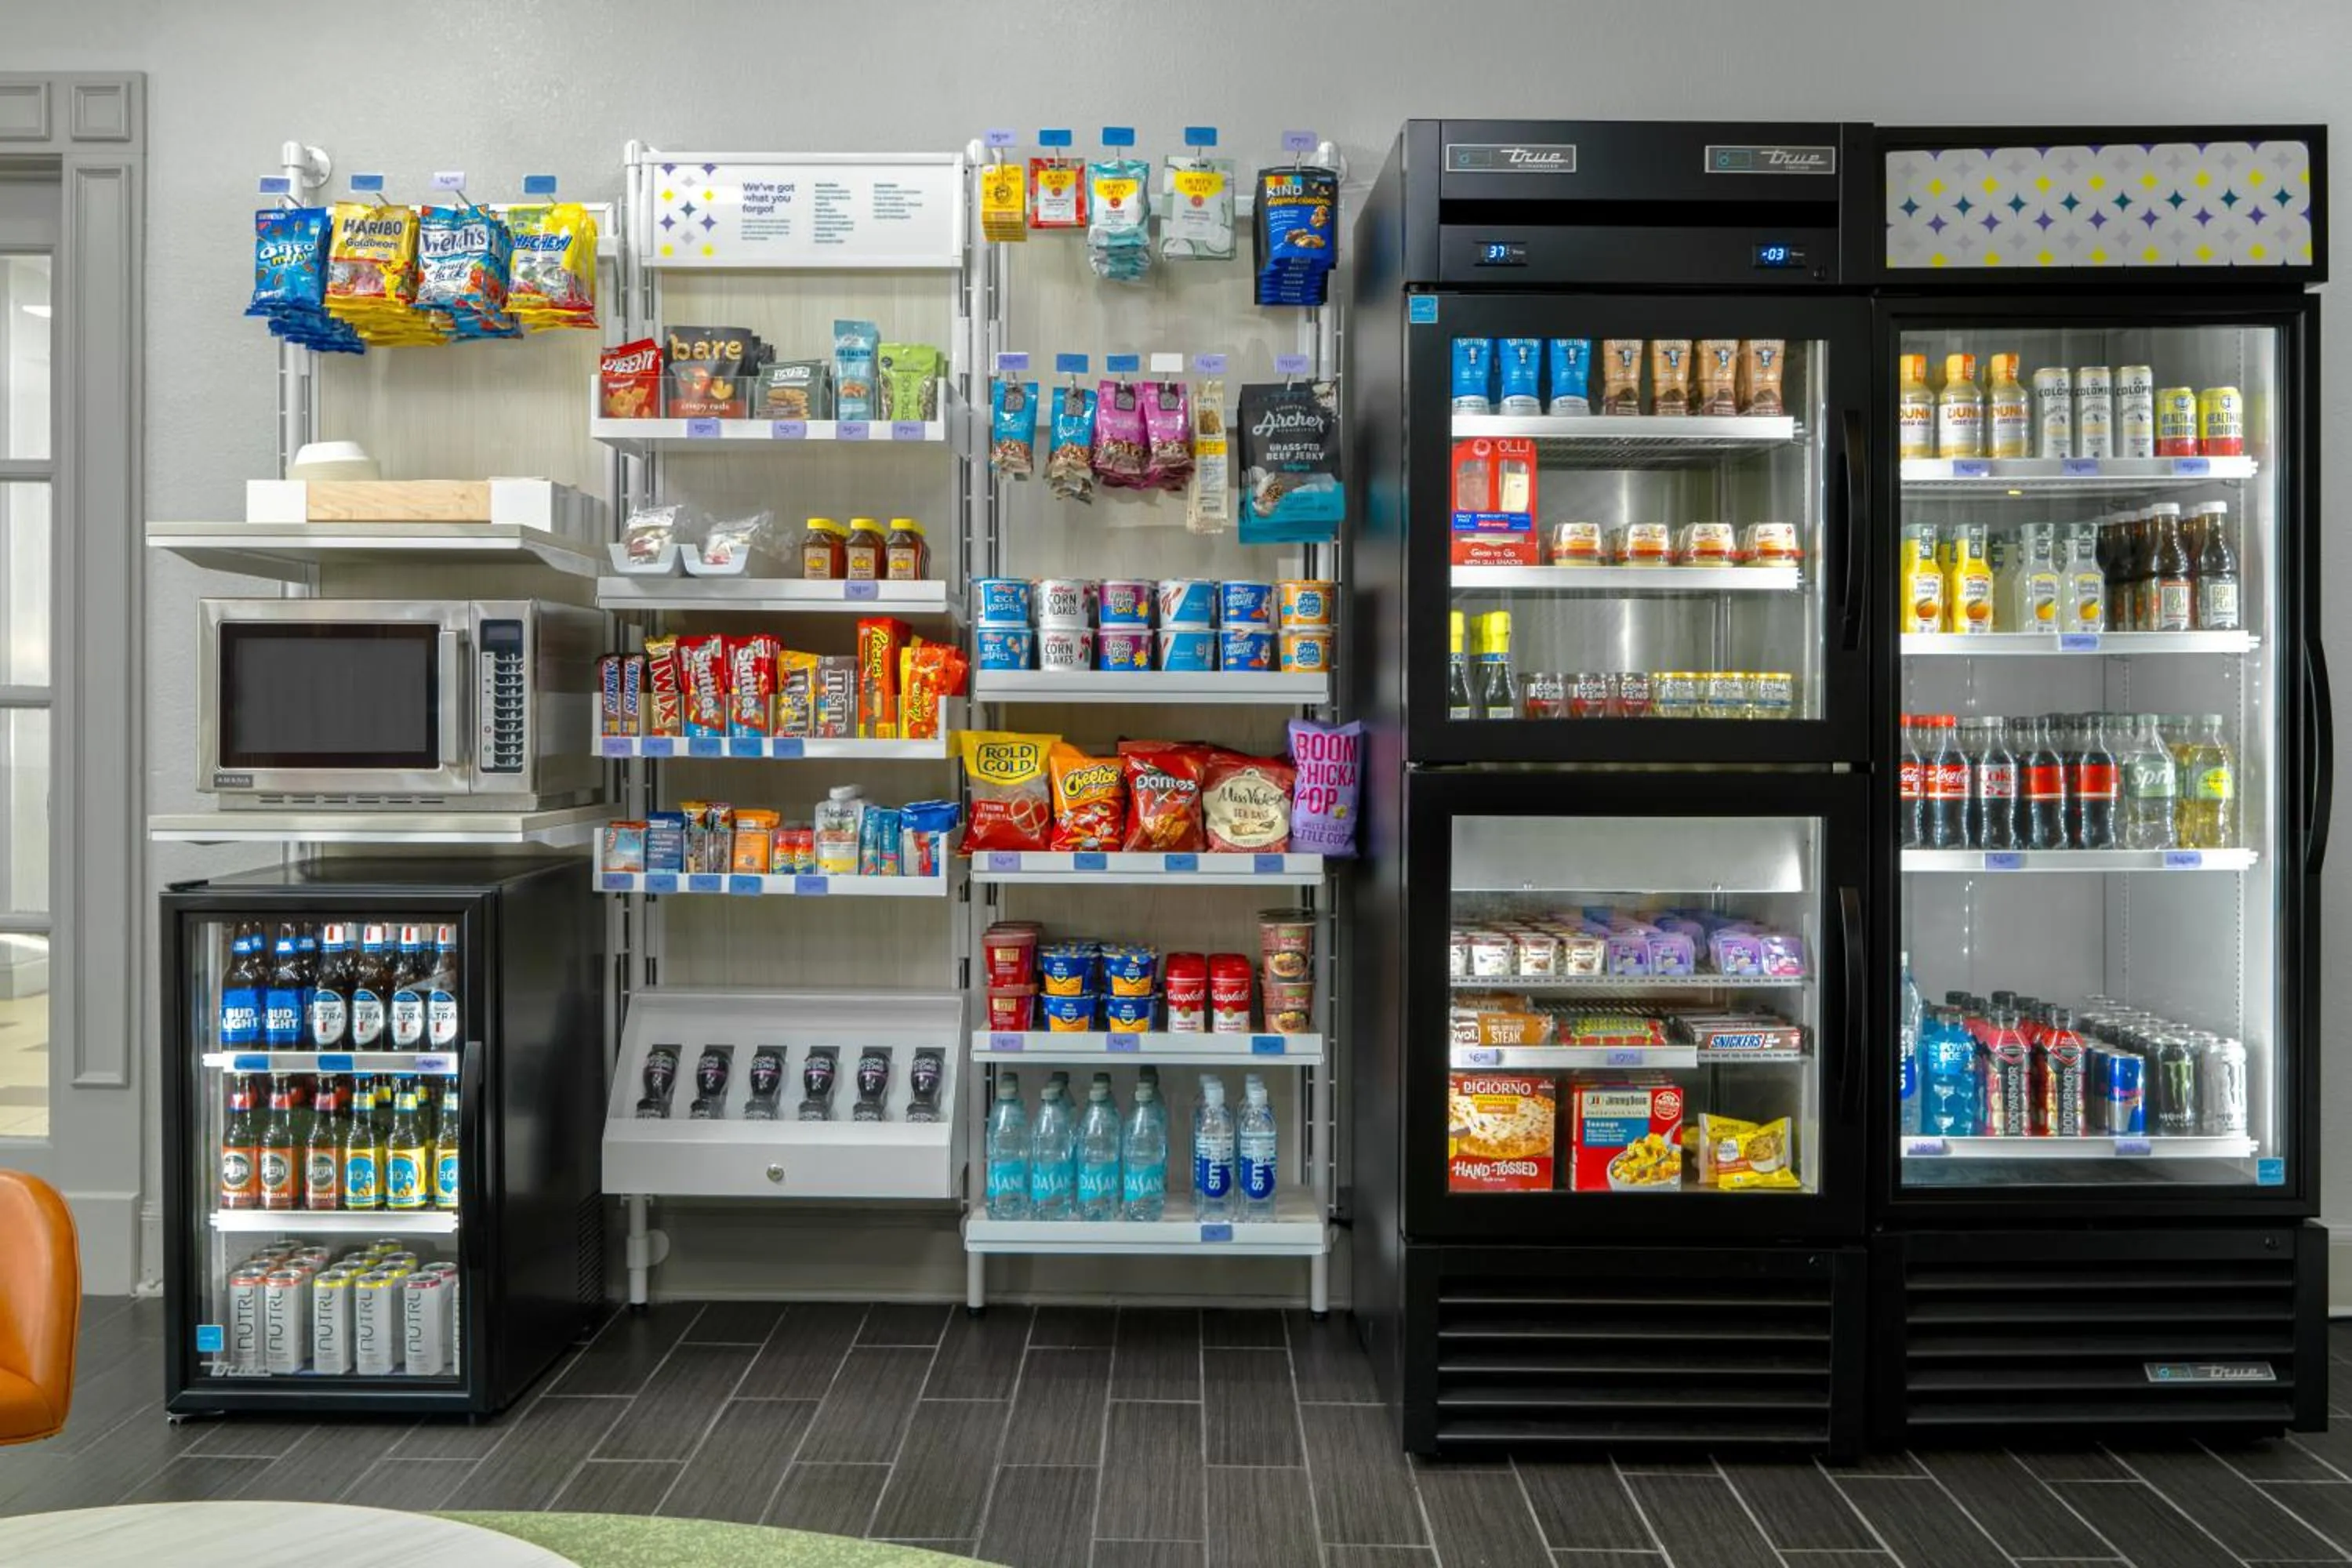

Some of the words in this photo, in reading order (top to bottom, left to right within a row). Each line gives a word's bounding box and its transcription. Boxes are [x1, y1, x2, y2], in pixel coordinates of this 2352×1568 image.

[742, 183, 774, 192] We've
[777, 184, 795, 195] got
[1266, 185, 1303, 198] KIND
[743, 193, 769, 202] what
[771, 194, 791, 207] you
[742, 204, 775, 215] forgot
[343, 219, 402, 236] HARIBO
[423, 227, 485, 252] Welch's
[1489, 245, 1504, 257] 37
[670, 332, 742, 360] bare
[1252, 410, 1325, 437] Archer
[1497, 440, 1529, 452] OLLI
[1265, 452, 1291, 461] BEEF
[1294, 452, 1325, 461] JERKY
[1049, 593, 1077, 605] CORN
[1048, 604, 1077, 615] FLAKES
[1045, 644, 1073, 655] CORN
[1045, 655, 1074, 666] FLAKES
[650, 650, 679, 723] TWIX
[693, 650, 715, 719] Skittles
[737, 648, 758, 719] Skittles
[985, 746, 1033, 759] ROLD
[983, 760, 1033, 773] GOLD
[1064, 768, 1118, 797] Cheetos
[1136, 774, 1196, 791] Doritos
[1297, 763, 1356, 787] CHICKA
[2131, 766, 2170, 789] Spri
[1218, 787, 1248, 804] Miss
[1294, 786, 1339, 815] POP
[824, 807, 854, 818] Noka
[225, 1007, 255, 1018] BUD
[1491, 1031, 1521, 1044] STEAK
[1711, 1034, 1762, 1049] SNICKERS
[1463, 1081, 1531, 1095] DIGIORNO
[2008, 1065, 2019, 1134] BODYARMOR
[2063, 1066, 2075, 1135] BODYARMOR
[1033, 1172, 1070, 1192] DASAN
[1078, 1174, 1117, 1192] DASAN
[1124, 1174, 1162, 1192] DASAN
